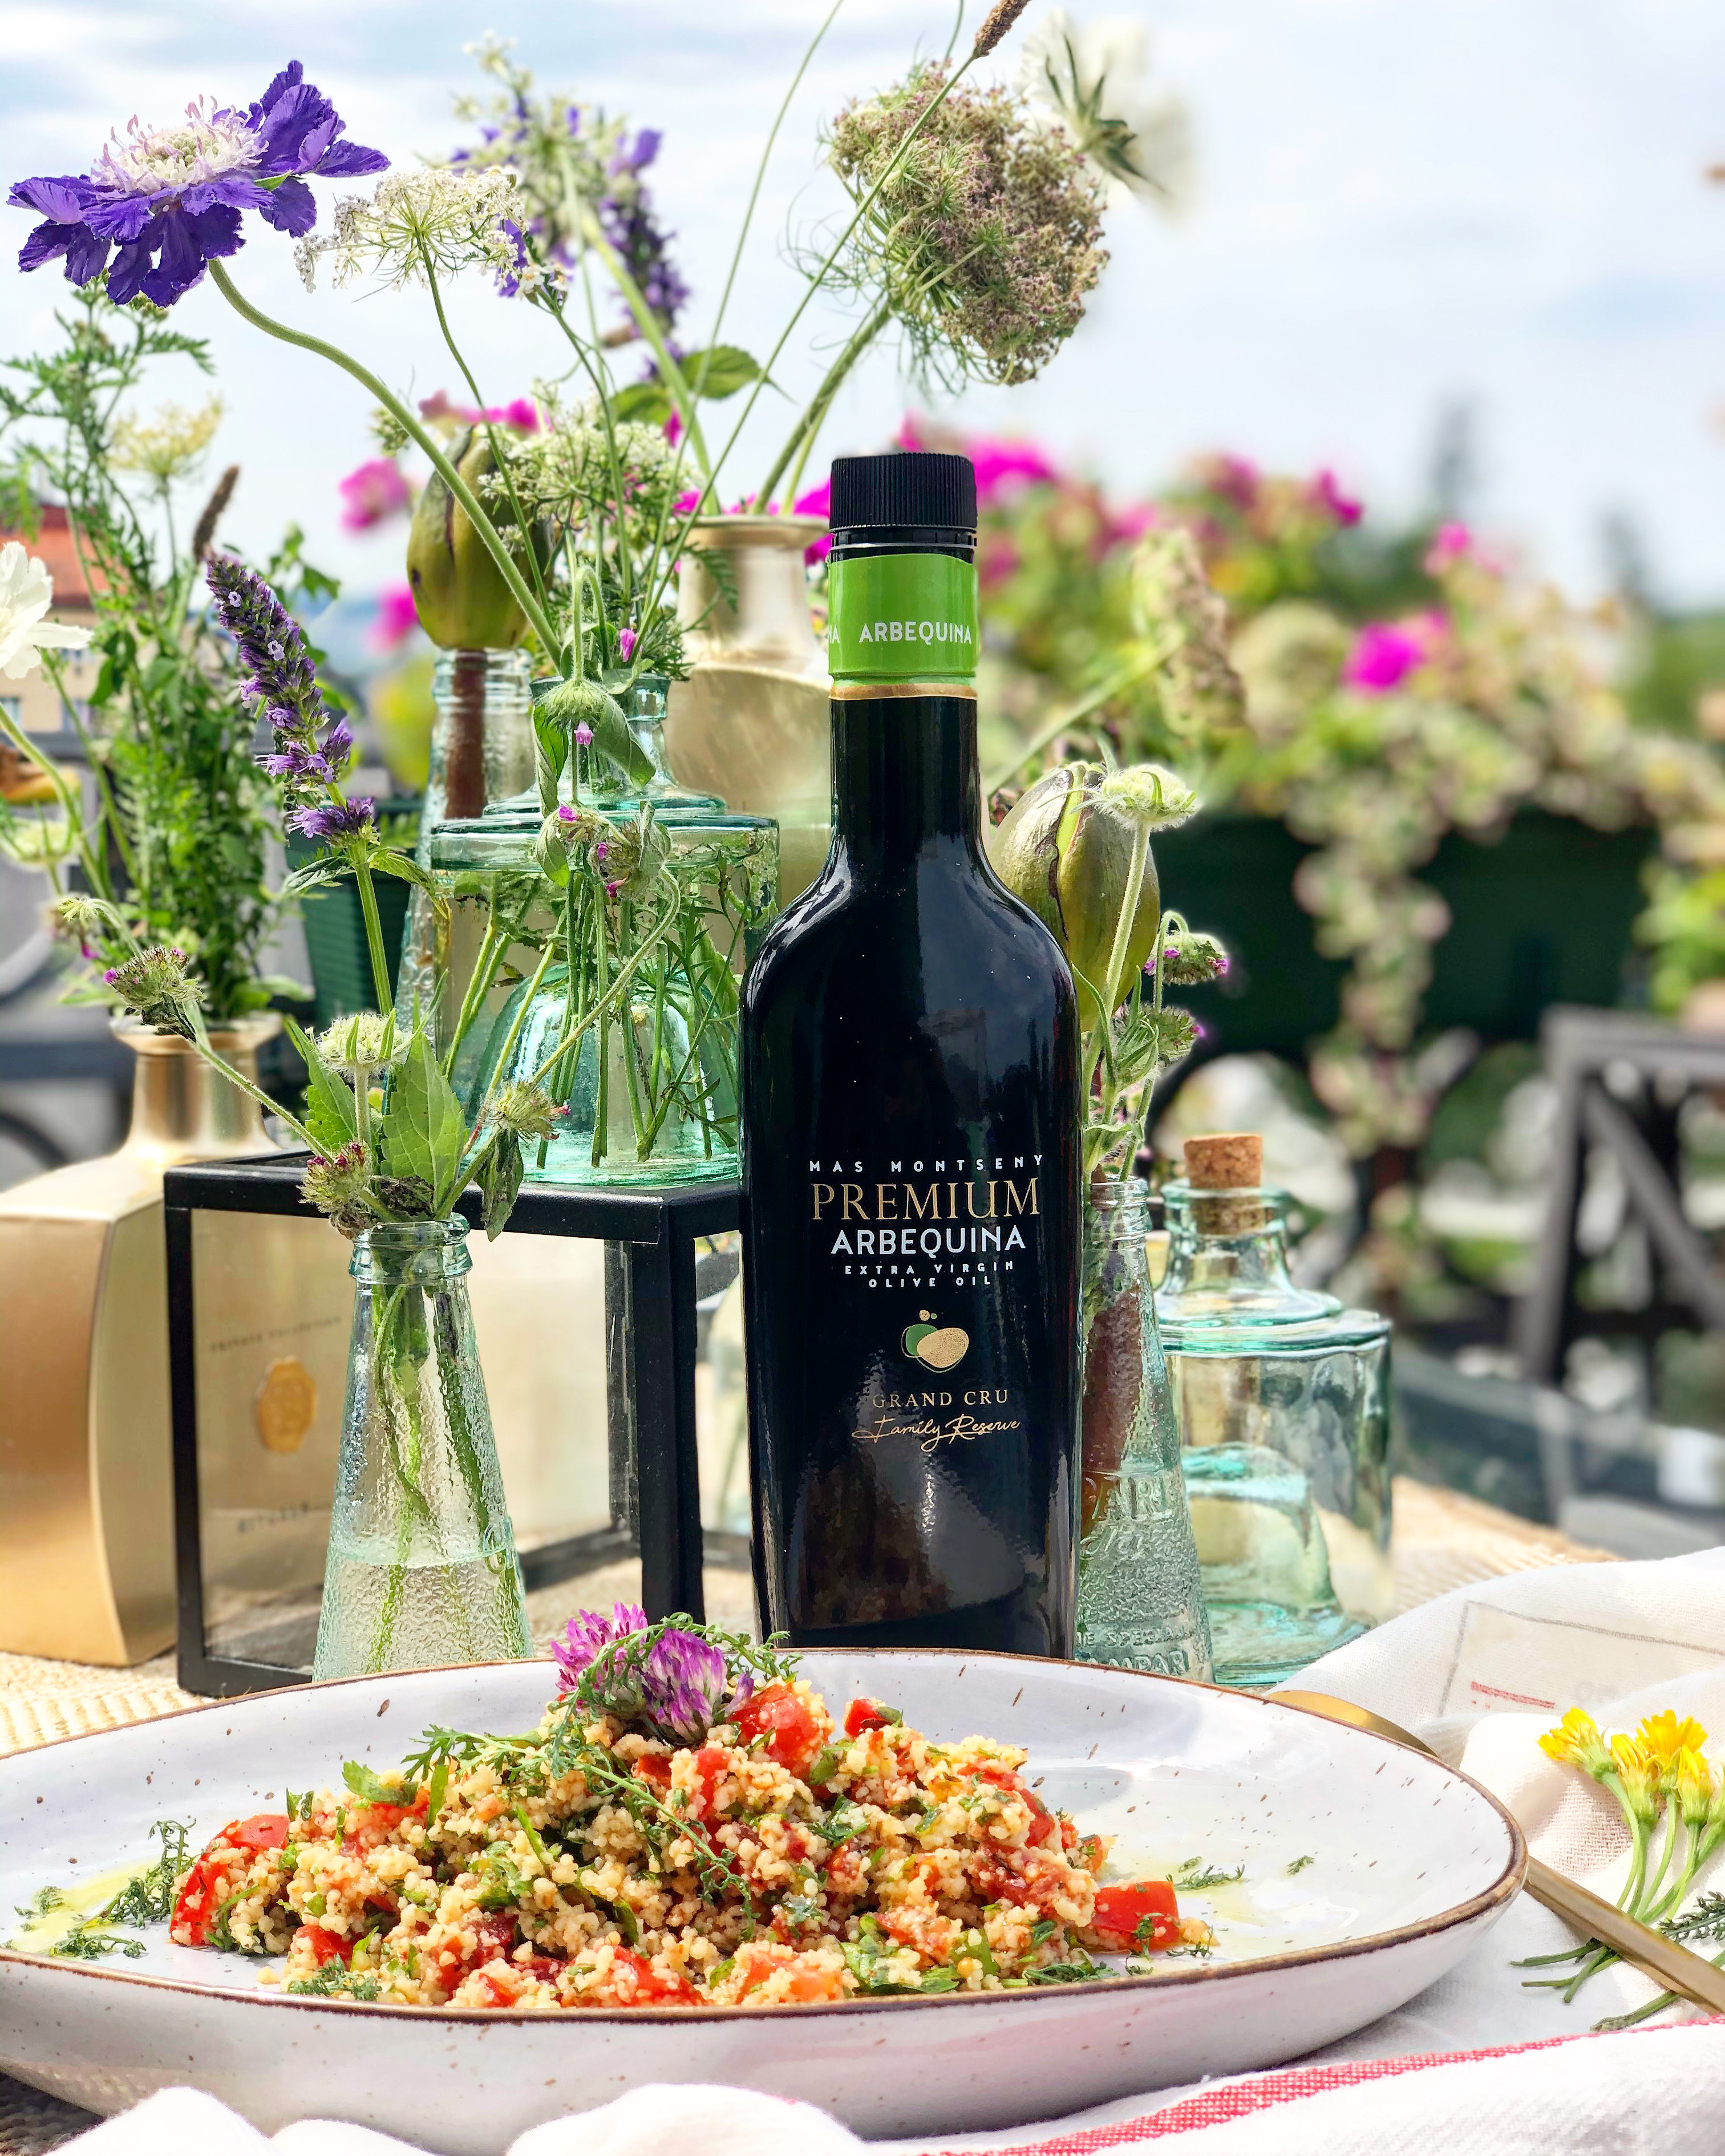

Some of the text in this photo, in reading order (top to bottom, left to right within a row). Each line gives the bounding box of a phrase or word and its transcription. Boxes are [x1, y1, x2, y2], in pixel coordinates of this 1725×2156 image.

[859, 621, 972, 646] ARBEQUINA
[809, 1154, 1043, 1173] MAS MONTSENY
[811, 1177, 1041, 1221] PREMIUM
[831, 1224, 1026, 1259] ARBEQUINA
[845, 1260, 1013, 1275] EXTRA VIRGIN
[868, 1275, 991, 1288] OLIVE OIL
[872, 1389, 1009, 1409] GRAND CRU
[851, 1413, 1021, 1453] Family Reserve
